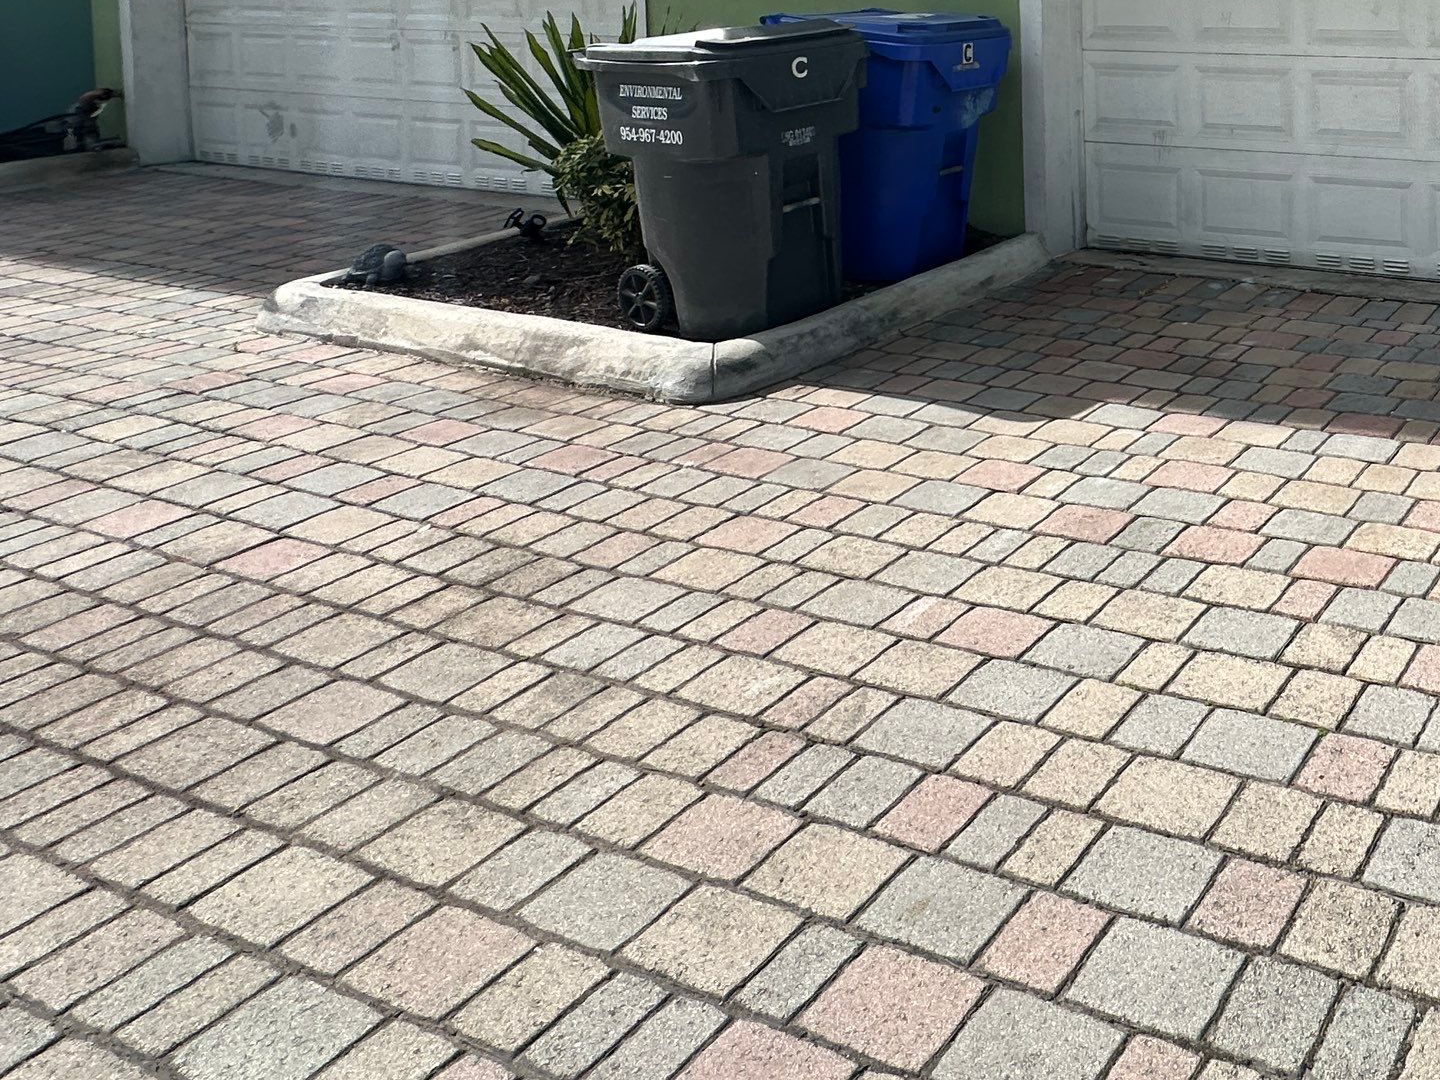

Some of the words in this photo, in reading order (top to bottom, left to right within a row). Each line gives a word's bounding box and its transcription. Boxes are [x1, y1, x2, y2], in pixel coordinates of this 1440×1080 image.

[963, 43, 973, 63] C
[791, 56, 808, 78] C
[619, 84, 683, 100] ENVIRONMENTAL
[631, 105, 668, 120] SERVICES
[619, 126, 683, 145] 954-967-4200
